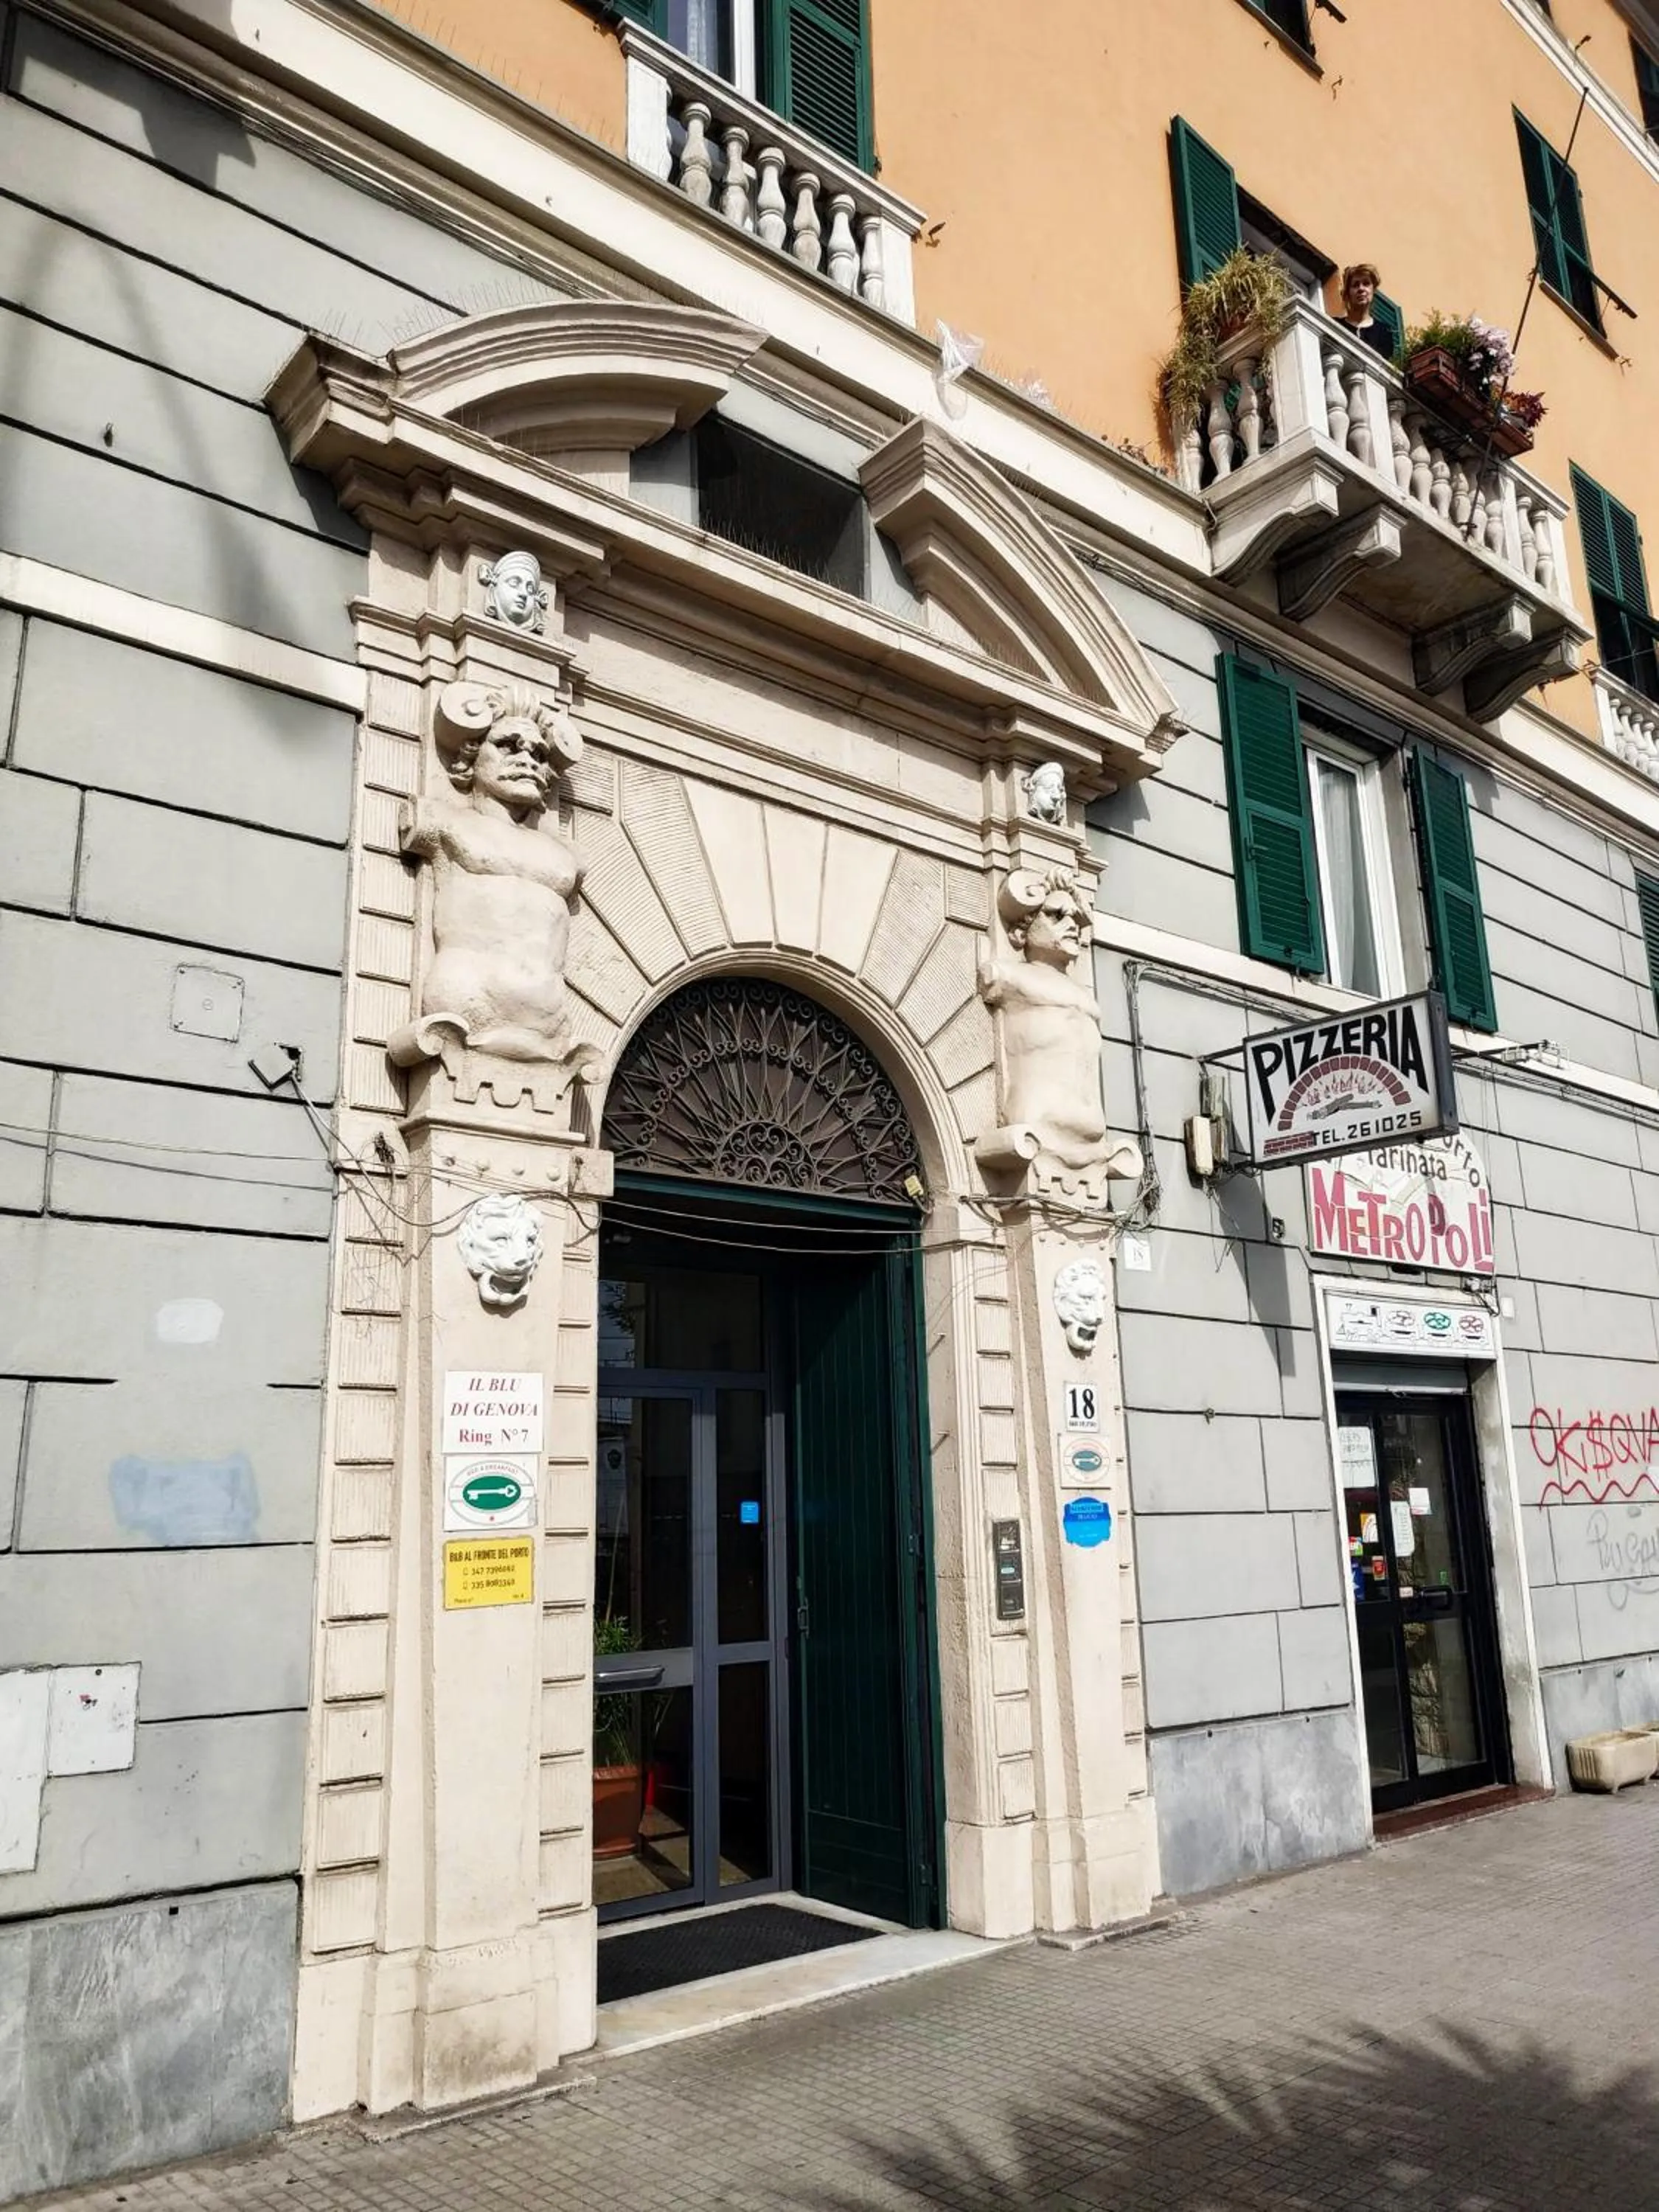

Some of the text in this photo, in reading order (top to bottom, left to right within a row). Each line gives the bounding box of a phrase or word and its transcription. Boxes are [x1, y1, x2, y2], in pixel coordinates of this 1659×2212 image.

[1251, 1005, 1429, 1127] PIZZERIA
[468, 1377, 521, 1392] IL BLU
[450, 1402, 538, 1416] DI GENOVA
[1068, 1387, 1095, 1419] 18
[459, 1428, 493, 1446] Ring
[521, 1428, 529, 1443] 7
[465, 1551, 473, 1562] AL
[473, 1549, 497, 1561] FRONTE
[498, 1548, 509, 1560] DEL
[509, 1546, 530, 1559] PORTO
